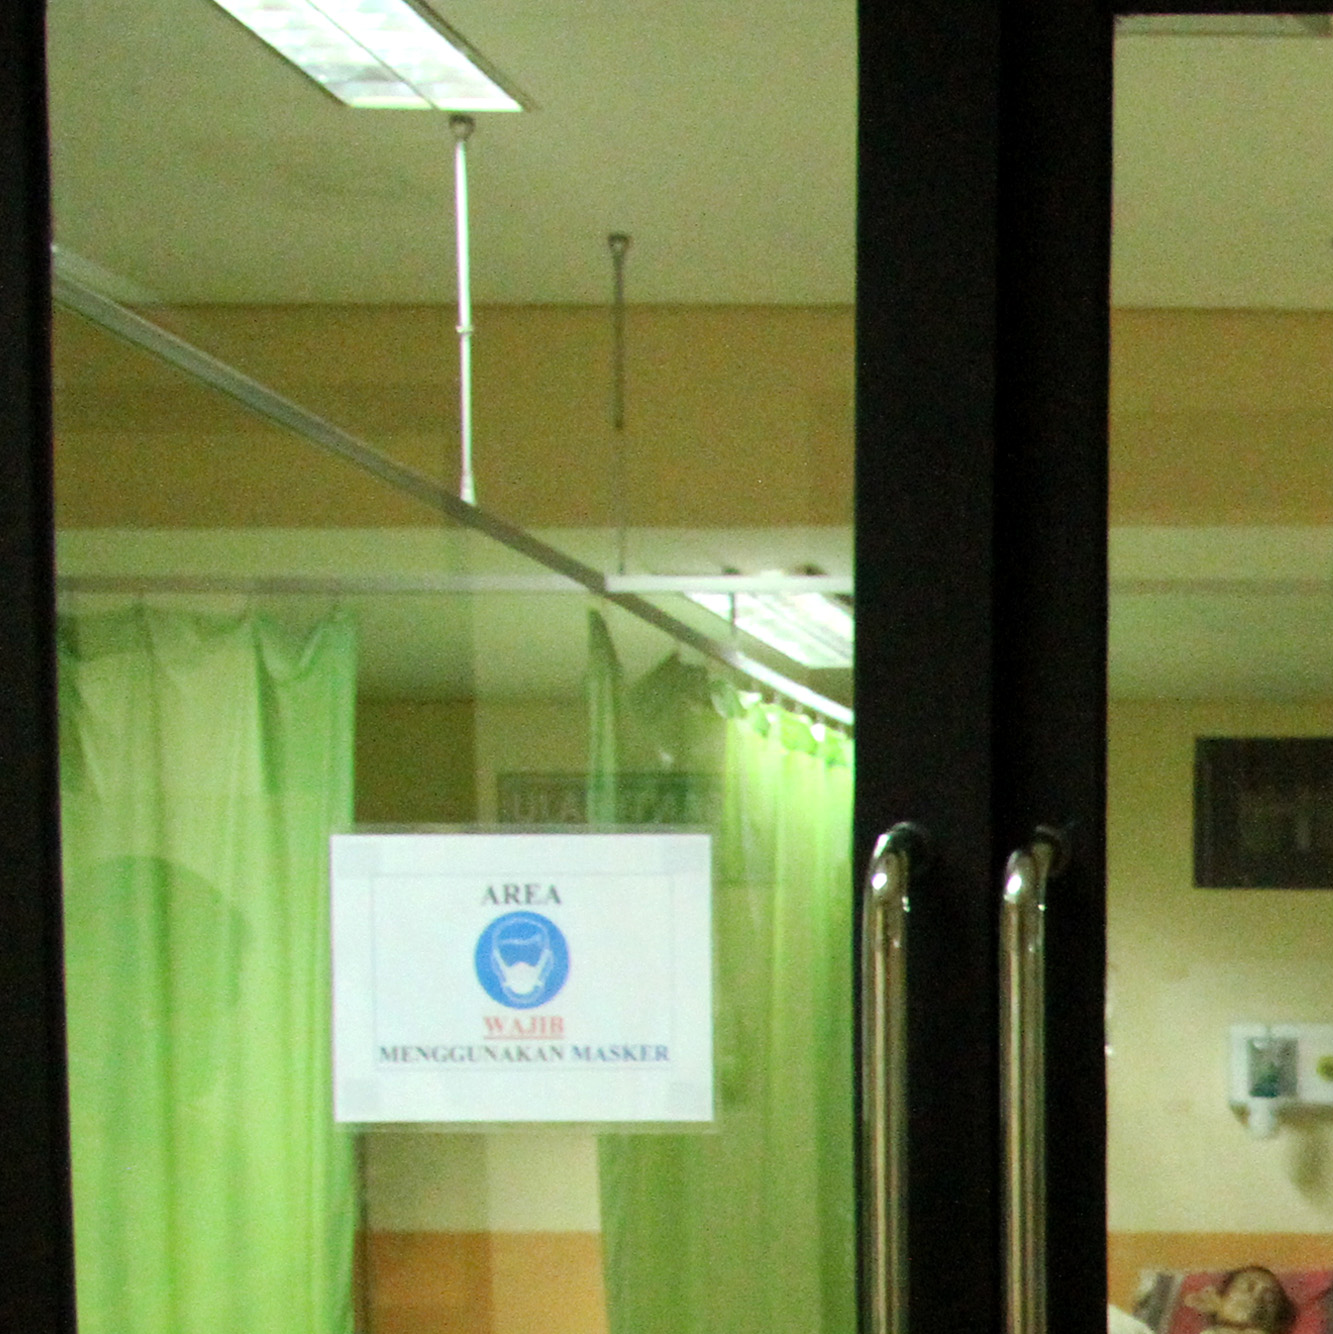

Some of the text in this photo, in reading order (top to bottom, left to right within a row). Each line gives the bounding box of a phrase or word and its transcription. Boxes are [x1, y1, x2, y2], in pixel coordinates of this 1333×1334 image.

[481, 884, 563, 905] AREA
[484, 1015, 565, 1040] WAJIB
[380, 1045, 670, 1064] MENGGUNAKAN MASKER
